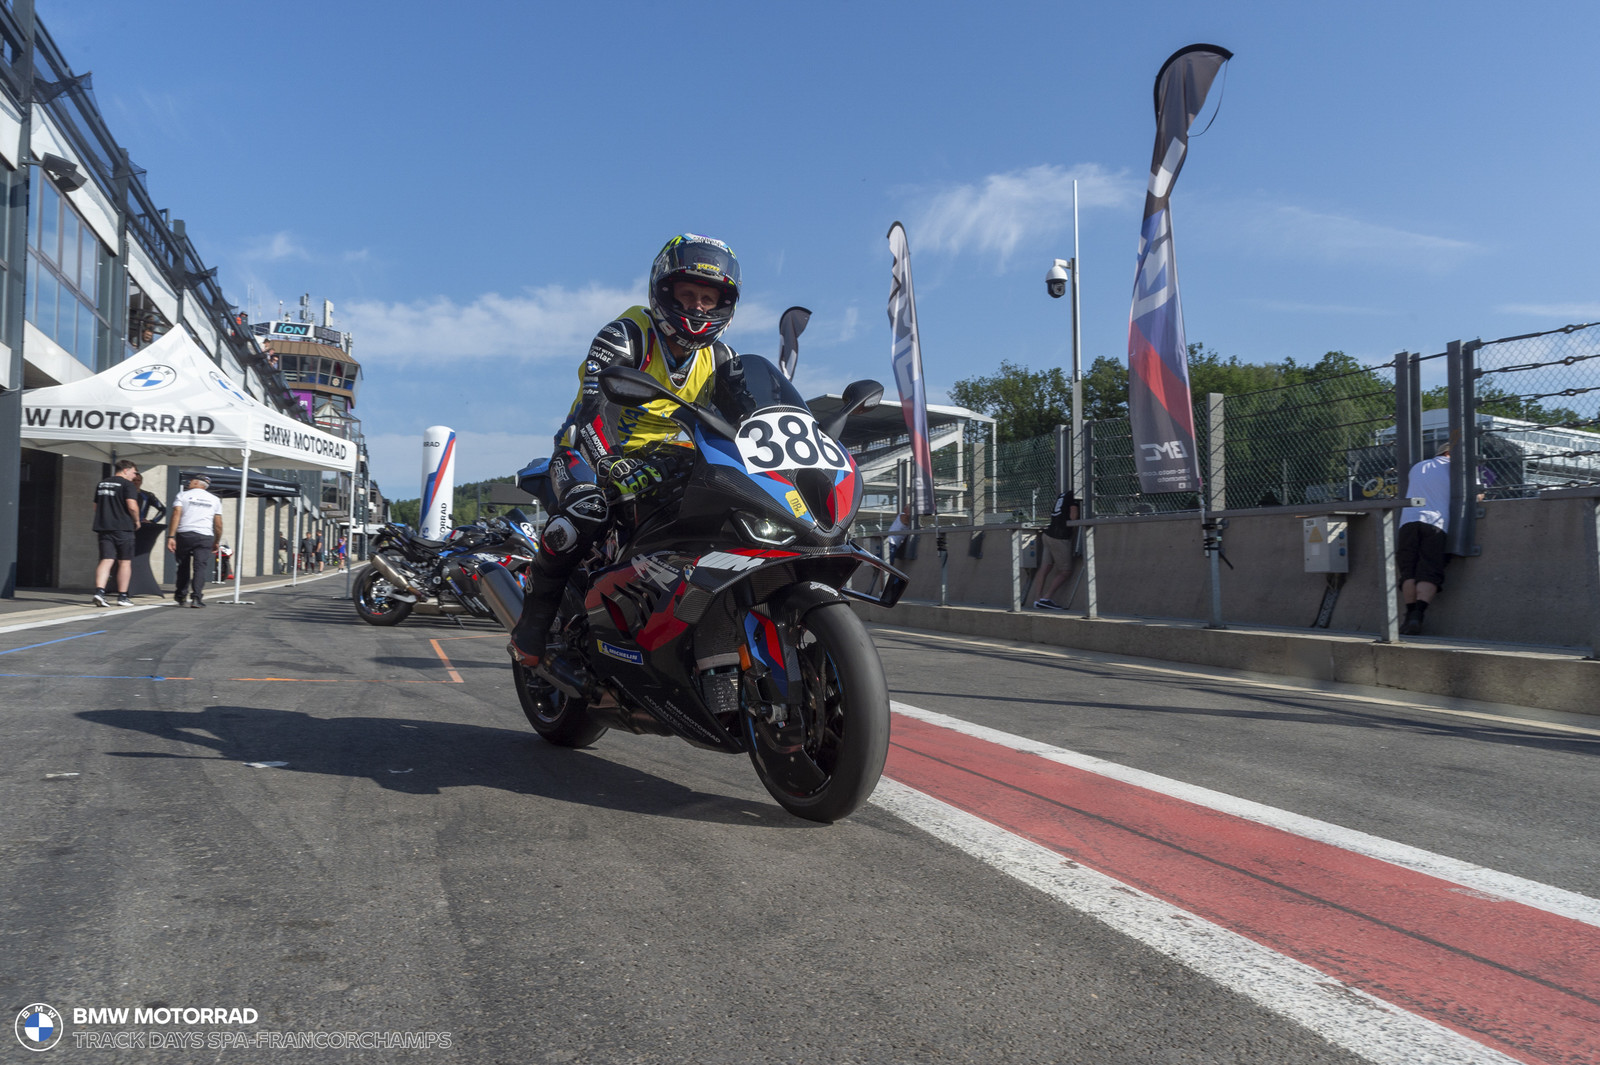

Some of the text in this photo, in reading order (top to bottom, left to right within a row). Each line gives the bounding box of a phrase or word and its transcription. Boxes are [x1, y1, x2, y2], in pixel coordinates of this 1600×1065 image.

[59, 410, 215, 435] MOTORRAD
[264, 423, 348, 461] BMW MOTORRAD
[739, 414, 847, 470] 386
[609, 648, 638, 661] MICHELIN
[666, 700, 721, 744] BMW MOTORRAD
